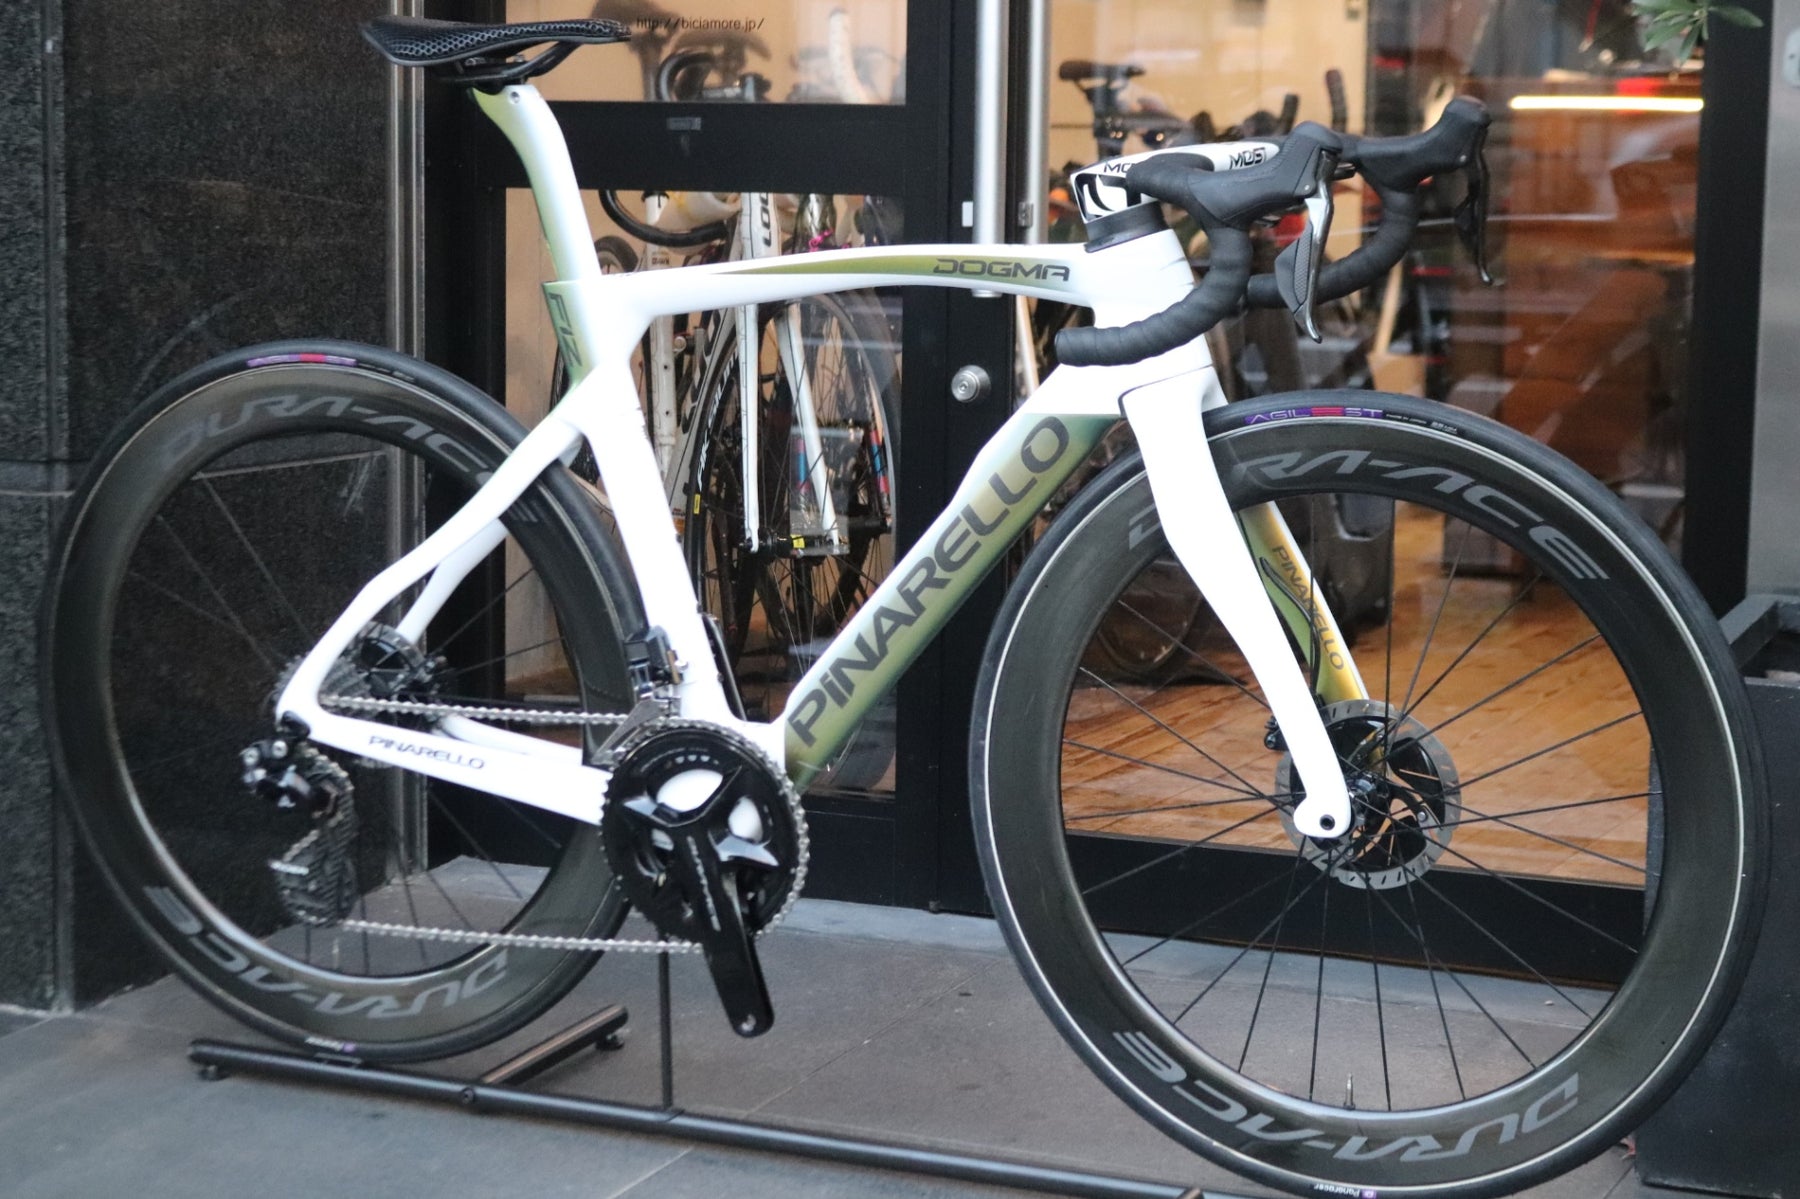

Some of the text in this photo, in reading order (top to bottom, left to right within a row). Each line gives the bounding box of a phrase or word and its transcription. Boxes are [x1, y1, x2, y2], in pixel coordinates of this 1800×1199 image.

[636, 17, 765, 32] http://biciamore.jp/
[1103, 163, 1137, 174] MO
[1229, 147, 1267, 170] MOST
[933, 258, 1071, 282] DOGMA
[1128, 450, 1609, 581] DRA-ACE
[369, 735, 485, 770] PINARELLO
[1113, 1031, 1579, 1162] DURA-ACE
